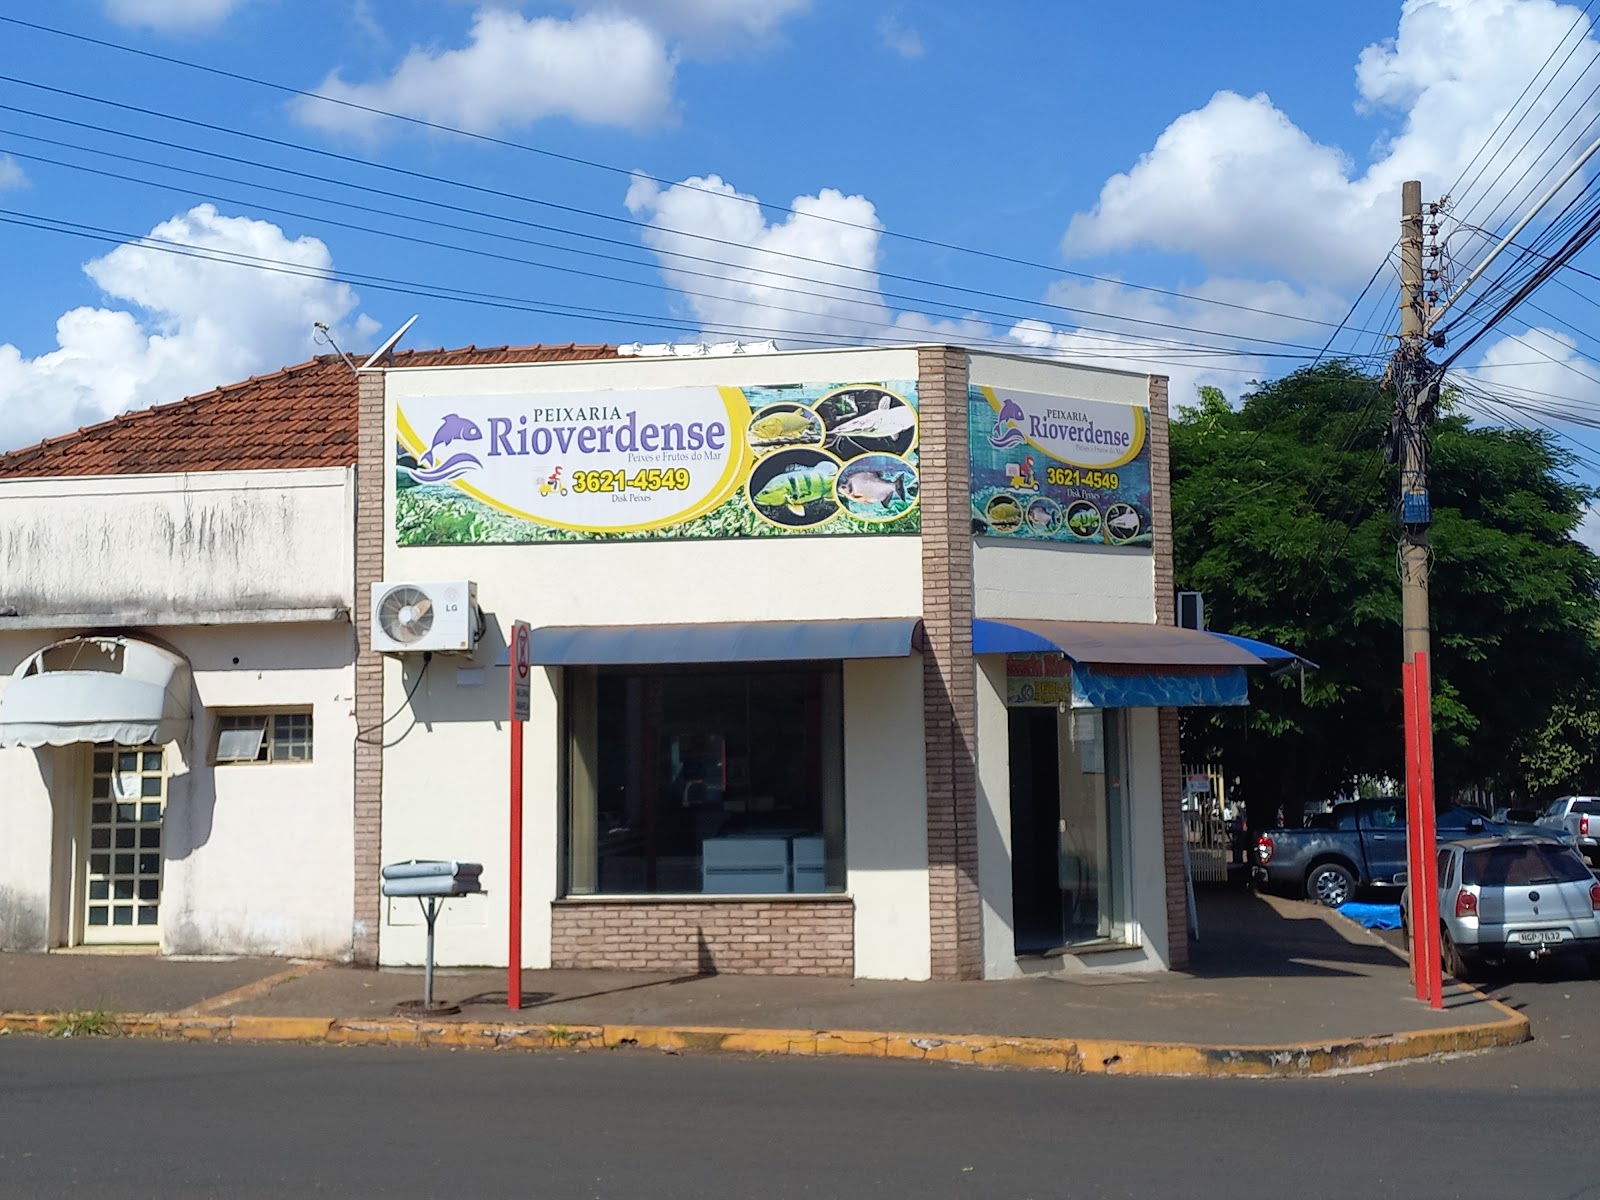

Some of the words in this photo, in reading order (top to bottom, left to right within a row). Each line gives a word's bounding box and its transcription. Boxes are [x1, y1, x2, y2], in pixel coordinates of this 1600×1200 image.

[533, 406, 622, 422] PEIXARIA
[1046, 409, 1088, 422] PEIXARIA
[487, 411, 726, 457] Rioverdense
[1029, 414, 1130, 447] Rioverdense
[628, 452, 654, 463] Peixes
[662, 452, 690, 461] Frutos
[691, 451, 702, 461] do
[704, 451, 722, 460] Mar
[572, 467, 691, 493] 3621-4549
[1046, 467, 1119, 490] 3621-4549
[611, 494, 628, 502] Disk
[629, 493, 652, 502] Peixes
[446, 604, 458, 612] LG
